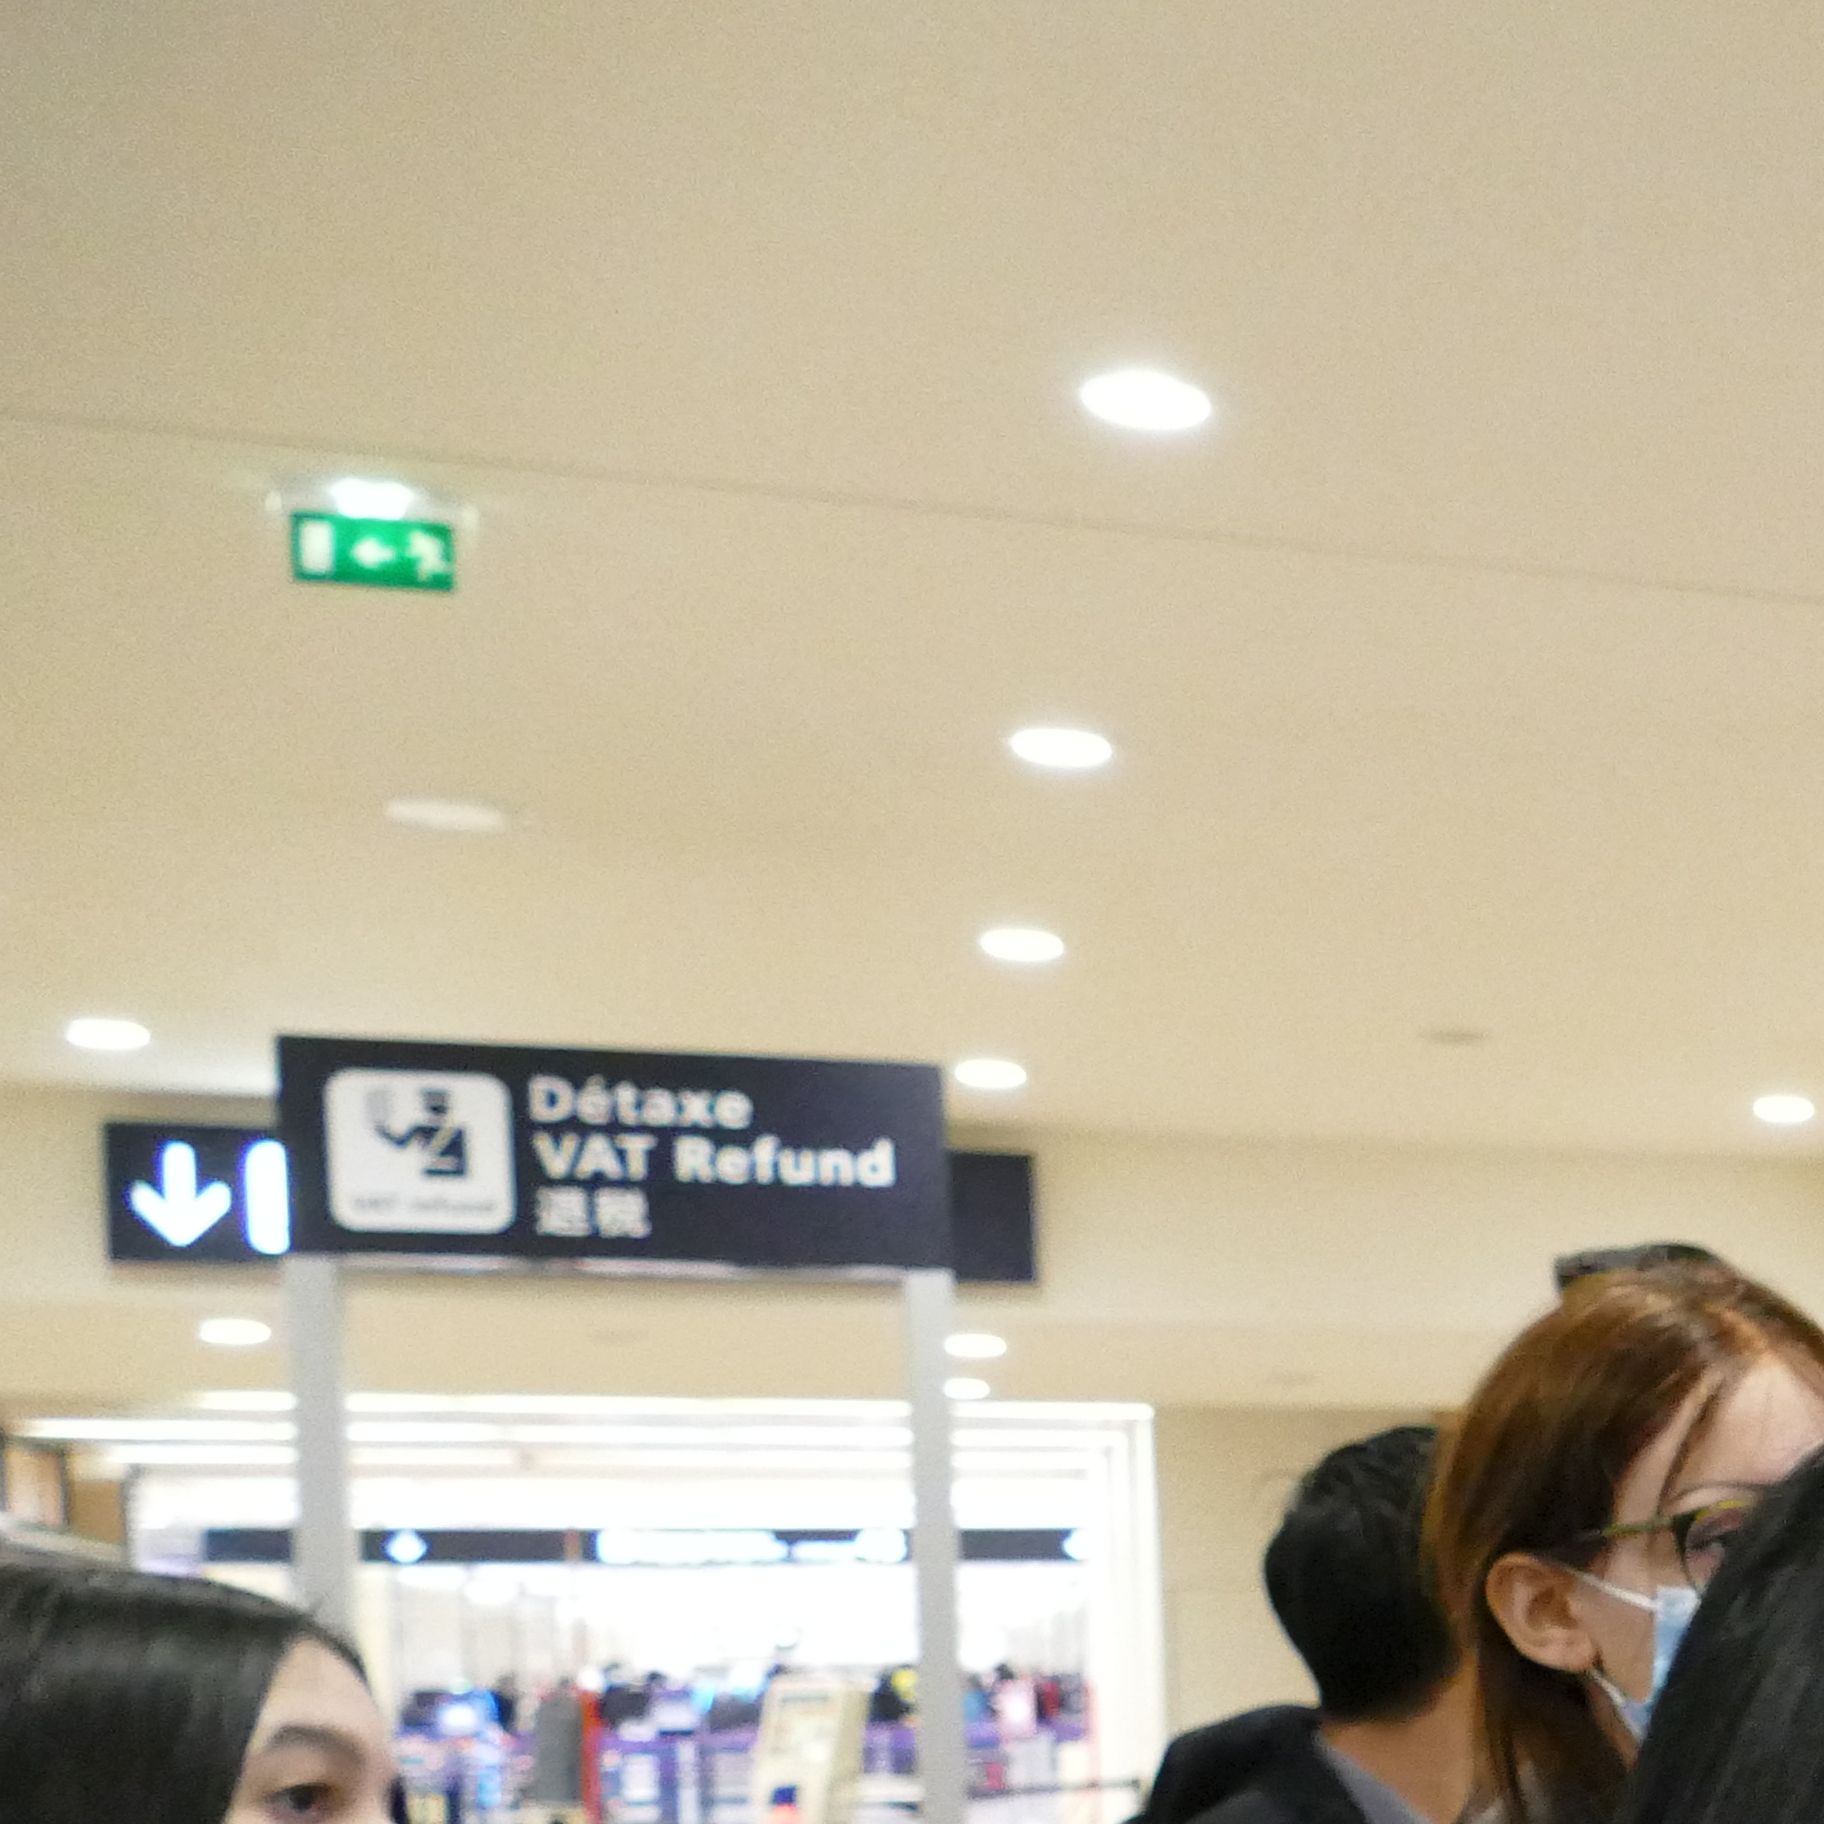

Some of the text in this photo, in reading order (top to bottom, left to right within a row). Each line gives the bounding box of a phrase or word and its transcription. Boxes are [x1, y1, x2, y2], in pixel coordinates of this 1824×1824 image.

[527, 1074, 754, 1130] Détaxe
[530, 1132, 898, 1187] VAT Refund
